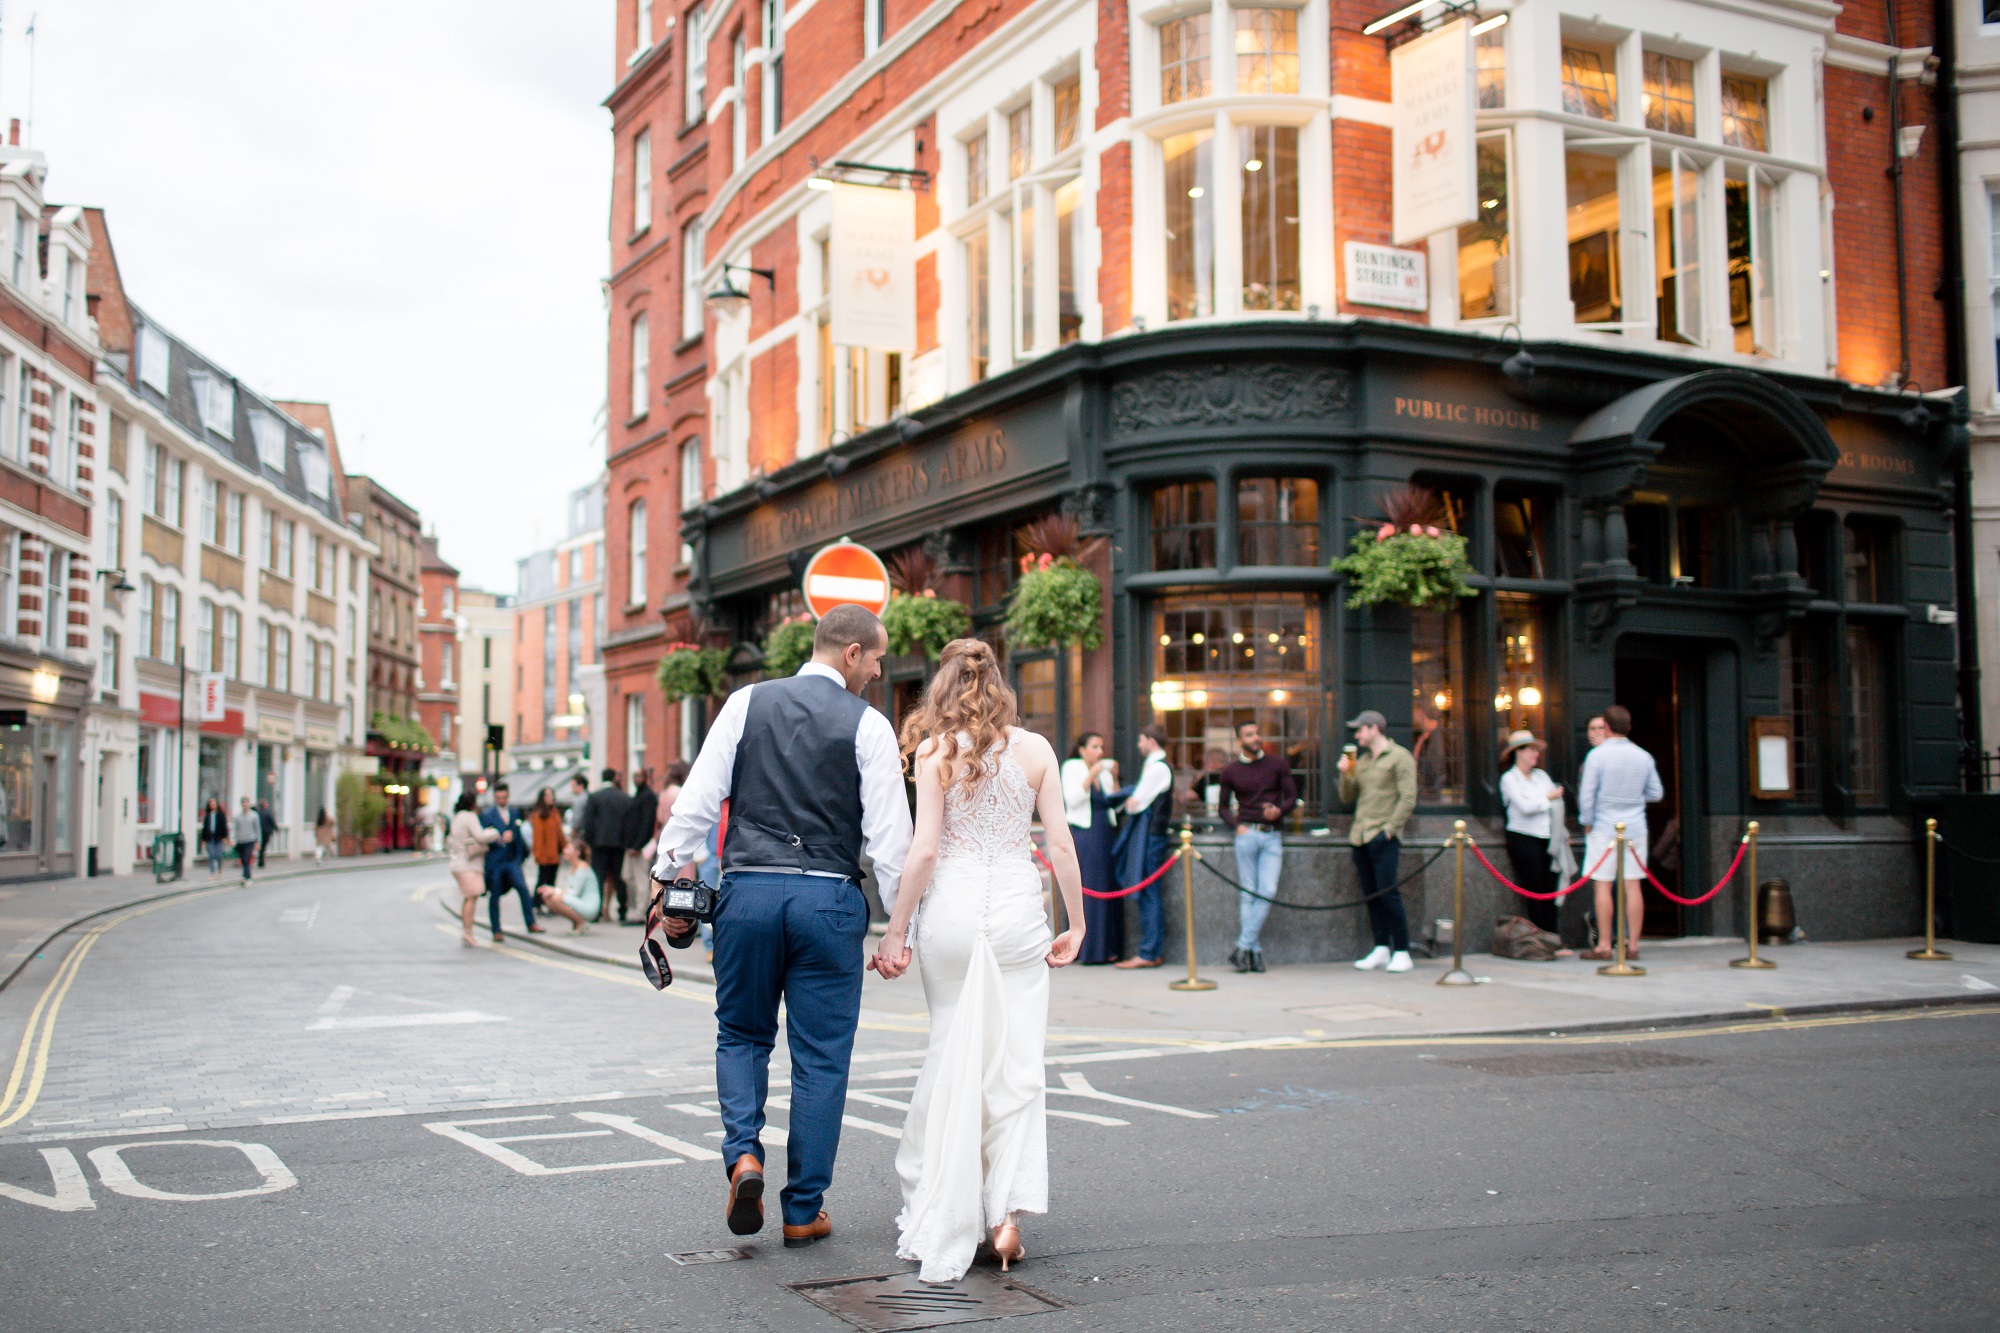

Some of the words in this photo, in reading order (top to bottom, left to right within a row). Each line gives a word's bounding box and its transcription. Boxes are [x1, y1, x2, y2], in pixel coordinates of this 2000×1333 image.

[1354, 249, 1416, 272] BENTINCK
[1355, 267, 1399, 287] STREET
[1394, 397, 1469, 423] PUBLIC
[1475, 406, 1542, 432] HOUSE
[1861, 453, 1917, 475] ROOMS
[779, 487, 842, 545] COACH
[845, 458, 931, 519] MAKERS
[938, 428, 1008, 490] ARMS
